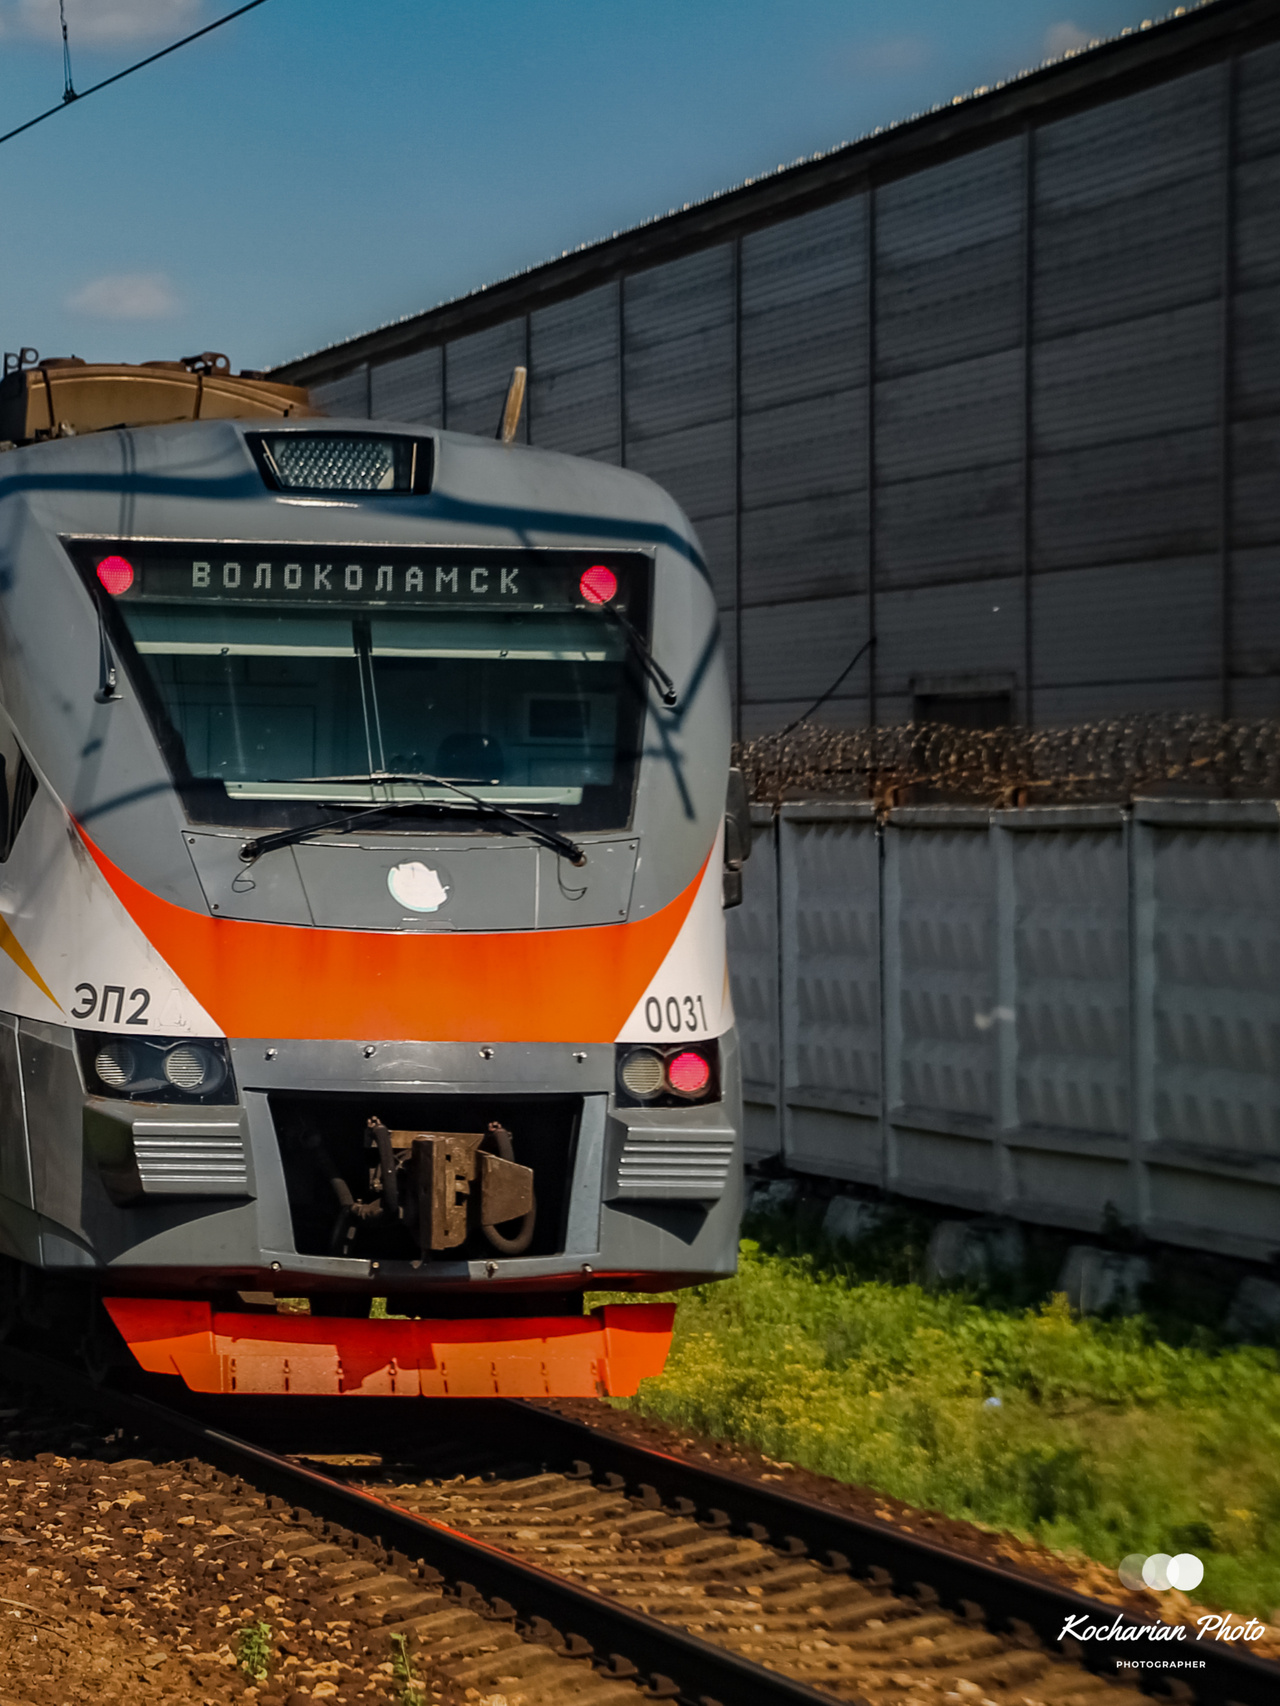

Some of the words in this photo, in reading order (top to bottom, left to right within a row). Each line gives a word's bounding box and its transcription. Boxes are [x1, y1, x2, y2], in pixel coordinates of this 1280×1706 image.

[192, 561, 519, 594] ВОЛОКОЛАМСК
[70, 982, 151, 1026] ЭП2
[645, 995, 708, 1033] 0031
